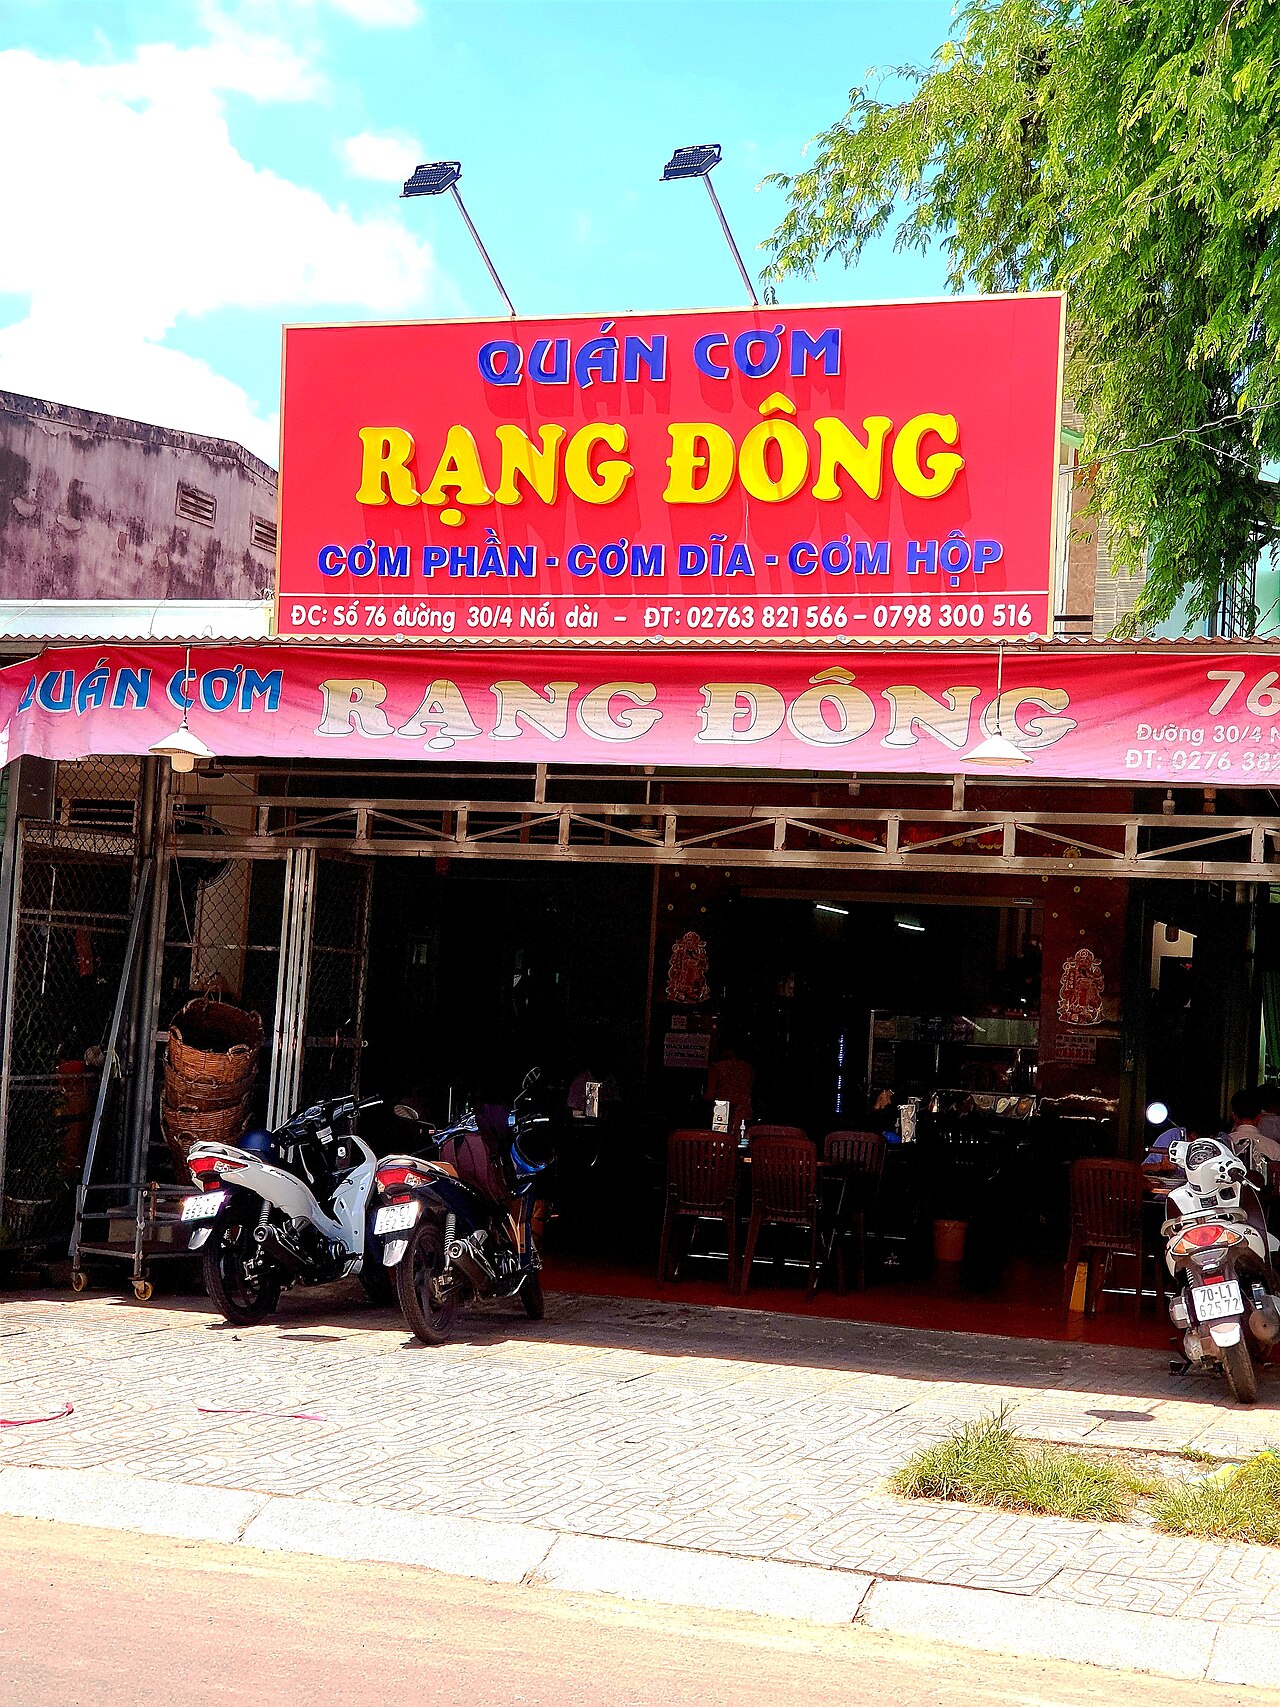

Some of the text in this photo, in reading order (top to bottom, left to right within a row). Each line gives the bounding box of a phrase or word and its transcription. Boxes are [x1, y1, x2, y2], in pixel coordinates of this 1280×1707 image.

[478, 321, 841, 389] QUÁN CƠM
[355, 391, 965, 526] RẠNG ĐÔNG
[318, 539, 411, 577] CƠM
[422, 528, 537, 578] PHẦN
[567, 538, 665, 577] CƠM
[677, 533, 755, 577] DĨA
[787, 534, 891, 576] CƠM
[906, 529, 1003, 588] HỘP
[290, 604, 328, 626] ĐC:
[332, 600, 360, 626] Số
[364, 605, 387, 627] 76
[393, 602, 456, 633] đường
[467, 605, 513, 627] 30/4
[519, 601, 555, 628] Nối
[565, 603, 599, 628] dài
[643, 606, 681, 628] ĐT:
[687, 605, 760, 628] 02763
[761, 605, 801, 628] 821
[805, 605, 848, 628] 566
[873, 604, 932, 628] 0798
[939, 604, 985, 628] 300
[992, 603, 1032, 627] 516
[165, 662, 285, 713] CƠM
[313, 665, 1078, 753] RẠNG ĐÔNG
[1206, 670, 1280, 717] 76
[1124, 748, 1163, 769] ĐT:
[1171, 750, 1232, 771] 0276
[1135, 723, 1205, 747] Đường
[1212, 725, 1262, 743] 30/4
[1200, 1284, 1232, 1303] 70-L1
